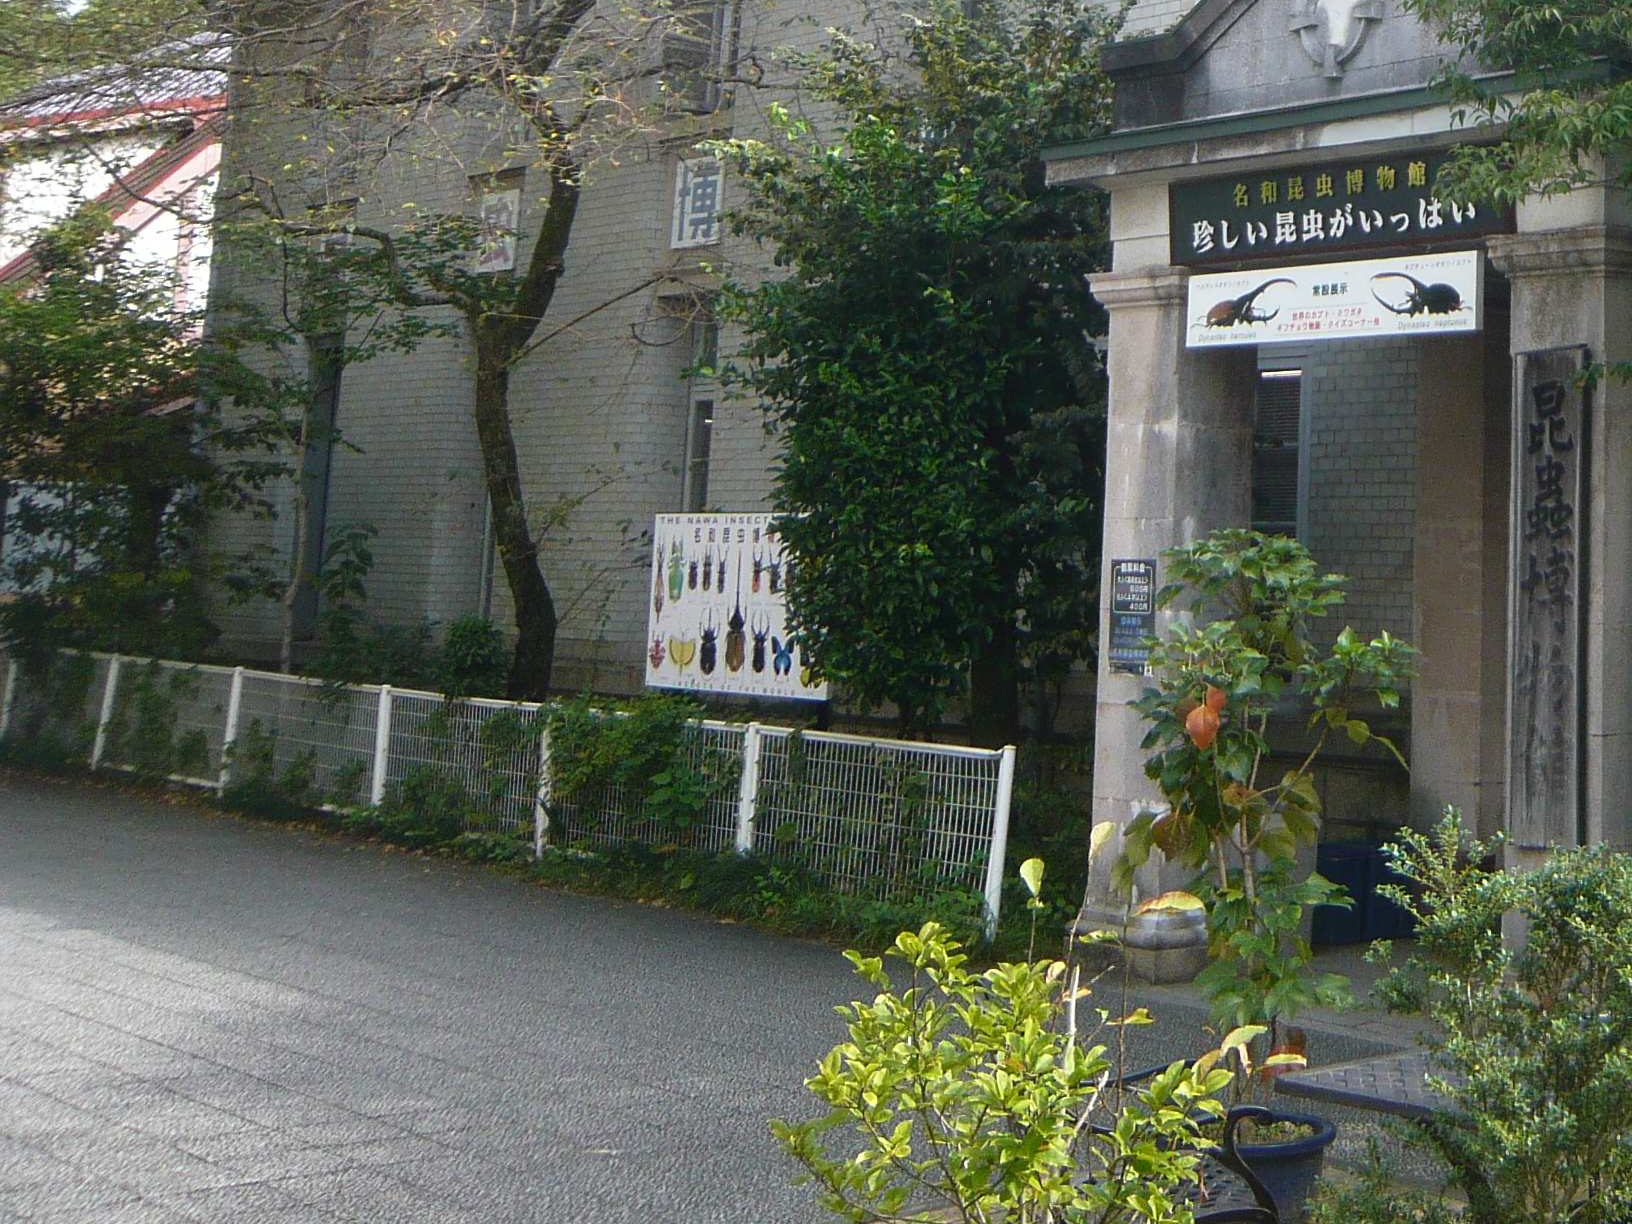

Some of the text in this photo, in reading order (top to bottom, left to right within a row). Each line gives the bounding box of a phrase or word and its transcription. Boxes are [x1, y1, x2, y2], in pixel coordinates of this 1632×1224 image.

[1233, 161, 1426, 207] 名和昆虫博物館
[1193, 197, 1475, 253] 珍しい昆虫がいっぱい
[661, 516, 680, 524] THE
[687, 516, 718, 524] NAWA
